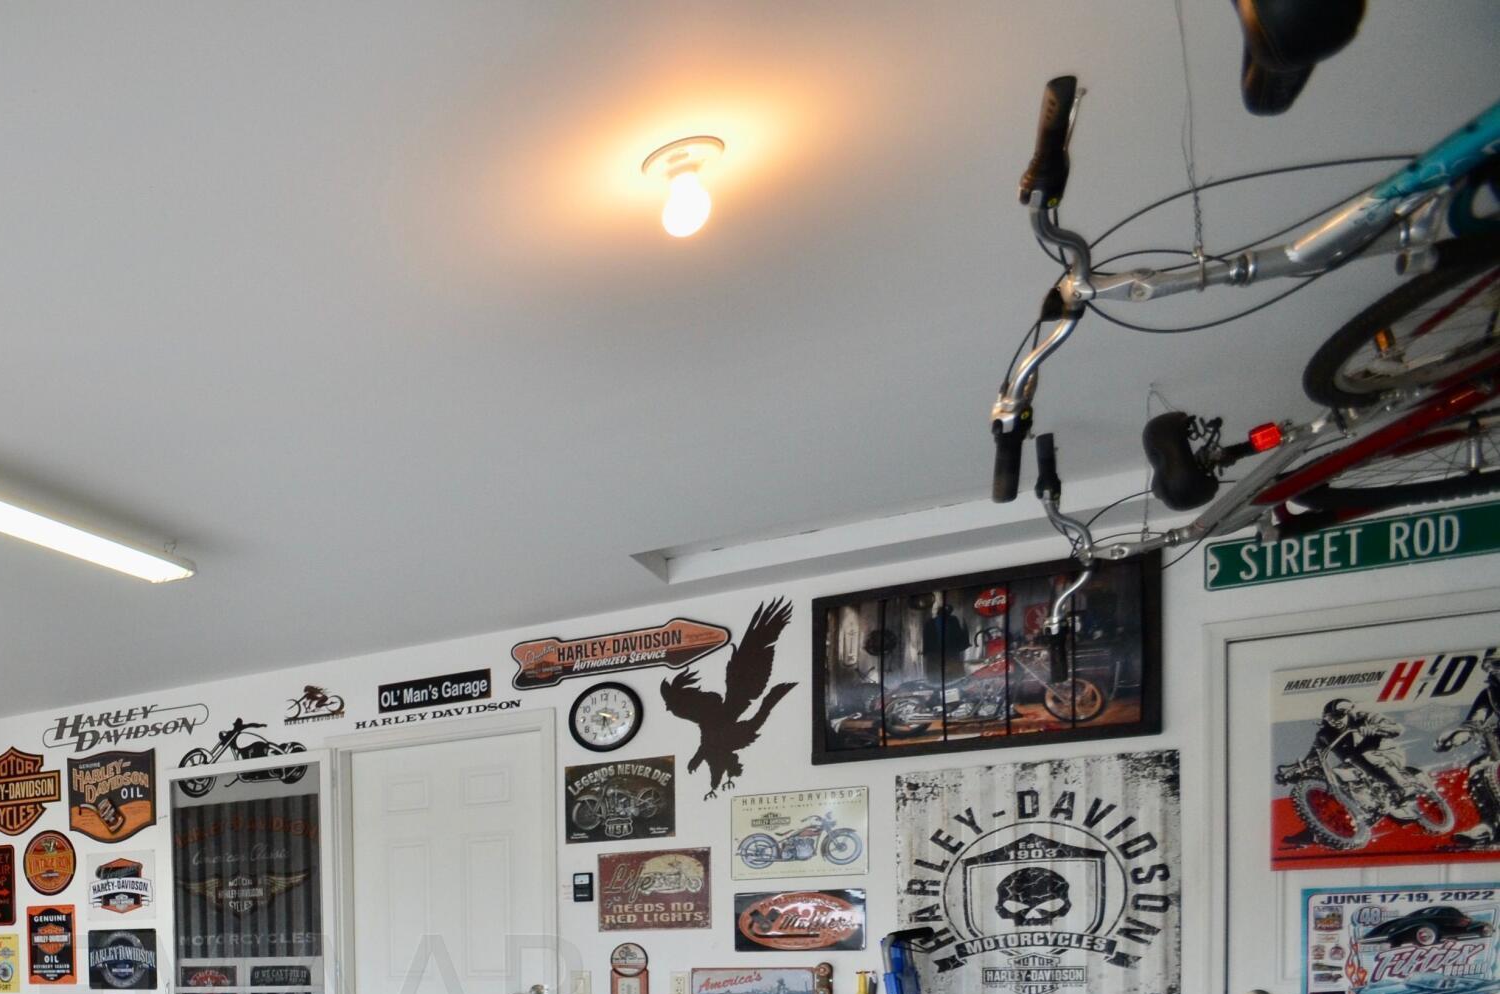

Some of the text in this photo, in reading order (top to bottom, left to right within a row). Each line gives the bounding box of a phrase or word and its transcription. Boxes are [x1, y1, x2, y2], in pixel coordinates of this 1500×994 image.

[1240, 514, 1460, 581] STREET ROD
[557, 630, 682, 662] HARLEY-DAVIDSON
[573, 654, 627, 672] AUTHORIZED
[629, 649, 667, 665] SERVICE
[1284, 670, 1386, 692] HARLEY-DAVIDSON
[380, 678, 489, 708] OL' Man's Garage
[54, 704, 158, 741] HARLEY
[355, 698, 522, 730] HARLEY DAVIDSON
[74, 717, 197, 752] DAVIDSON
[84, 771, 149, 804] DAVIDSON
[567, 763, 672, 796] LEGENDS NEVER DIE
[121, 787, 143, 799] OIL
[609, 824, 629, 835] USA
[1007, 849, 1058, 860] 1903
[1018, 841, 1045, 850] Est.
[92, 879, 149, 894] HARLEY-DAVIDSON
[604, 863, 656, 909] Life
[1321, 894, 1372, 905] JUNE
[1436, 891, 1494, 902] 2022
[604, 911, 702, 925] RED LIGHTS
[964, 932, 1107, 953] MOTORCYCLES
[44, 955, 59, 963] OIL
[1012, 955, 1054, 967] MOTOR
[699, 971, 763, 992] America's
[986, 969, 1083, 982] HARLEY-DAVIDSON
